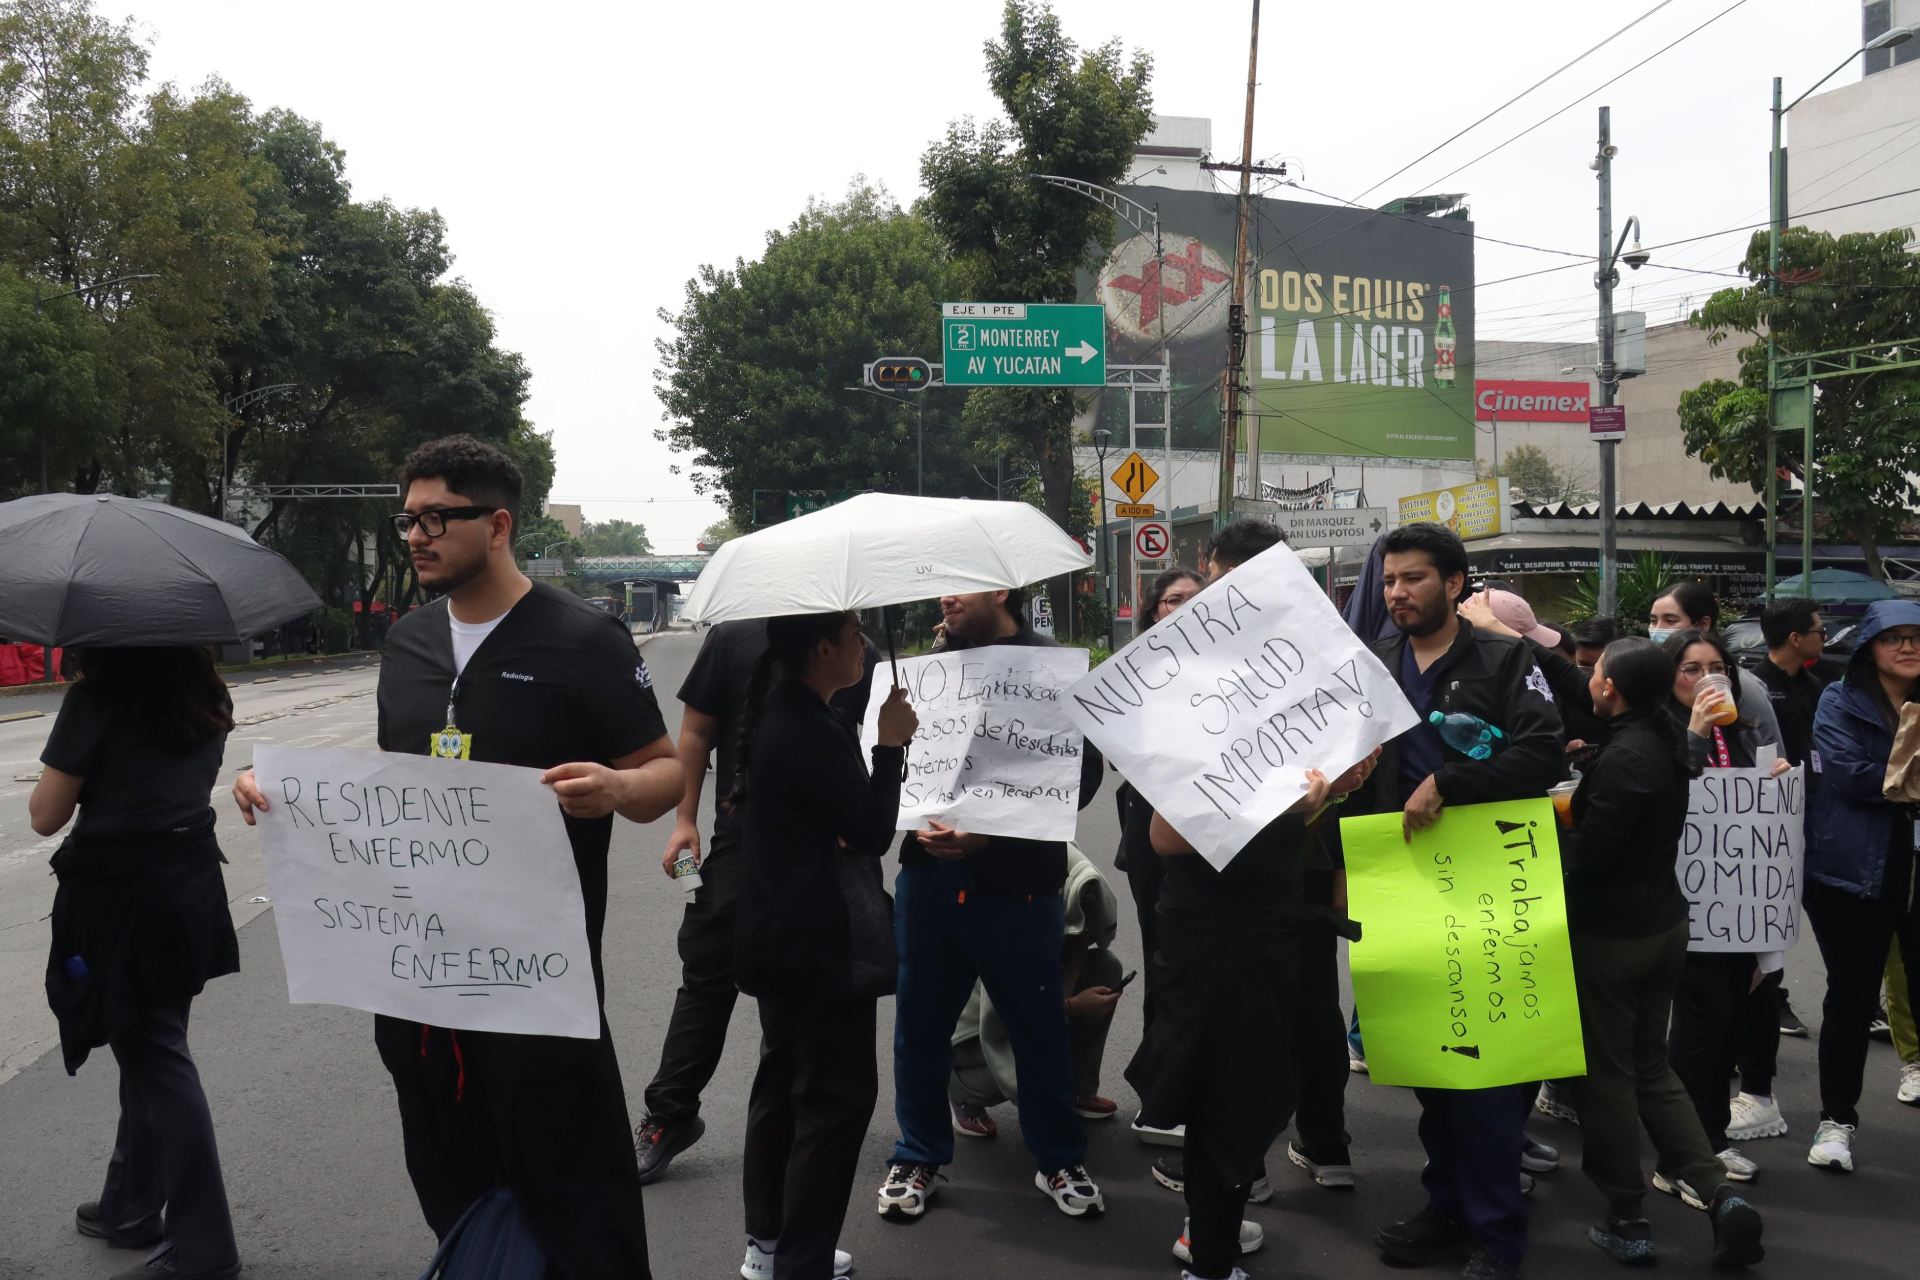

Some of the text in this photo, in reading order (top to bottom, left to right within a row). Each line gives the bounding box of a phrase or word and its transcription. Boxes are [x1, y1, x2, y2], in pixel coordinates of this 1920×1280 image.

[952, 306, 1015, 315] EJE 1 PTE
[1260, 269, 1424, 321] DOS EQUIS
[957, 331, 969, 345] 2
[980, 329, 1059, 347] MONTERREY
[1261, 316, 1425, 388] LA LAGER
[967, 356, 1061, 375] AV YUCATAN
[1478, 389, 1588, 412] Cinemex
[1121, 507, 1127, 515] A
[1128, 507, 1141, 515] 100
[1290, 517, 1355, 527] DR MARQUEZ
[1284, 528, 1364, 539] SAN LUIS POTOSI
[916, 564, 932, 574] UV
[1035, 617, 1054, 628] PEN
[1073, 584, 1261, 726] NUESTRA
[900, 660, 947, 703] NO
[1191, 638, 1304, 735] SALUD
[912, 715, 967, 741] asos
[974, 711, 1003, 741] de
[1193, 659, 1374, 820] IMPORTA!
[907, 751, 974, 778] nfermos
[281, 777, 491, 828] RESIDENTE
[1686, 776, 1802, 816] ESIDENC
[329, 833, 489, 868] ENFERMO
[1434, 851, 1455, 894] sin
[1684, 860, 1796, 901] OMIDA
[314, 898, 445, 941] SISTEMA
[1688, 901, 1796, 943] EGURA
[391, 945, 569, 982] ENFERMO
[1478, 893, 1507, 1023] enfermos
